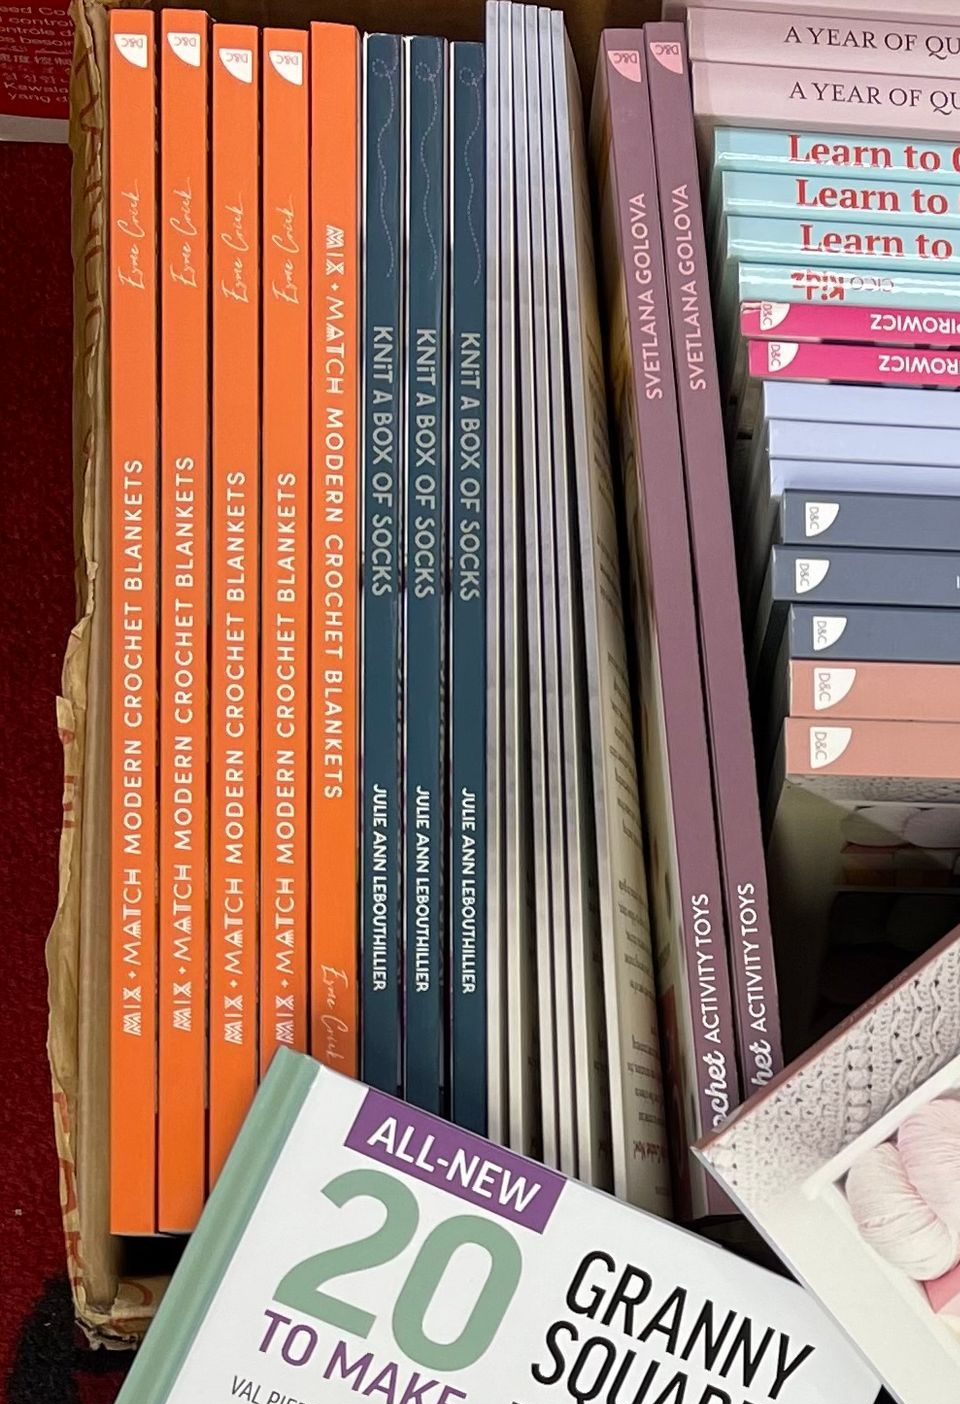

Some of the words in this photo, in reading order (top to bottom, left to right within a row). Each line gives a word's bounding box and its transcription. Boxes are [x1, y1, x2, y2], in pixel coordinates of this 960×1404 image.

[784, 26, 802, 43] A
[806, 28, 875, 49] YEAR
[884, 32, 917, 51] OF
[628, 192, 652, 284] GOLOVA
[795, 178, 901, 212] Learn
[911, 189, 947, 214] to
[639, 289, 663, 400] SVETLANA
[372, 390, 392, 404] A
[372, 412, 393, 464] BOX
[124, 459, 142, 590] BLANKETS
[371, 472, 392, 508] OF
[371, 513, 392, 598] SOCKS
[123, 602, 142, 728] CROCHET
[818, 672, 831, 702] D&C
[122, 740, 142, 855] MODERN
[372, 783, 387, 828] JULIE
[372, 831, 387, 872] ANN
[123, 868, 142, 966] MATCH
[372, 876, 387, 991] LEBOUTHILLIER
[691, 893, 713, 948] TOYS
[123, 986, 142, 1037] MIX
[697, 950, 721, 1044] ACTIVITY
[366, 1116, 543, 1214] ALL-NEW
[271, 1167, 524, 1374] 20
[256, 1309, 319, 1368] TO
[565, 1249, 817, 1400] GRANNY
